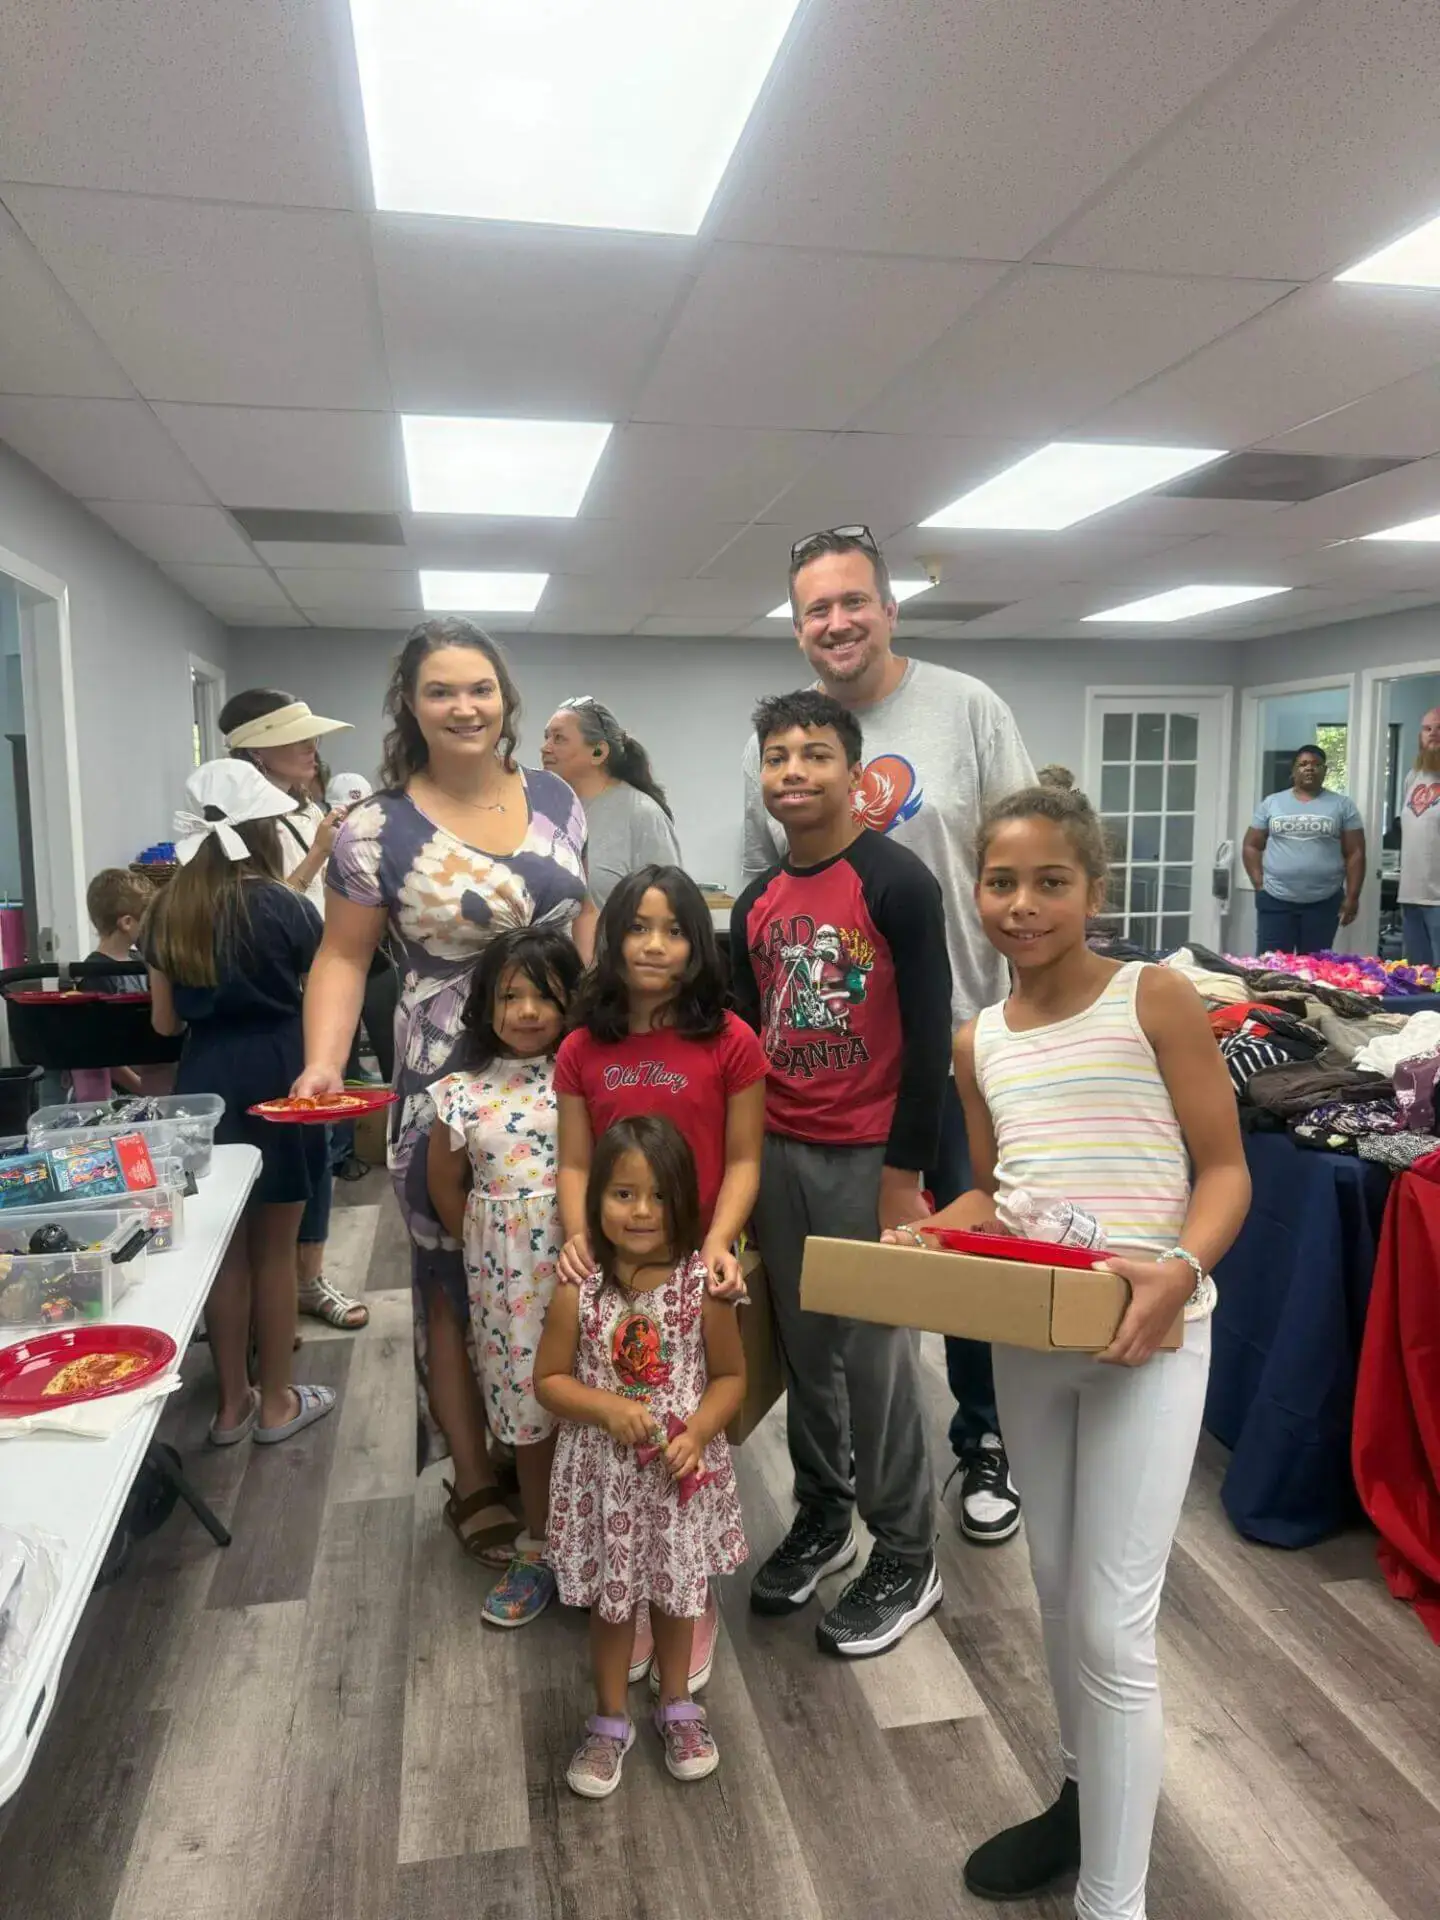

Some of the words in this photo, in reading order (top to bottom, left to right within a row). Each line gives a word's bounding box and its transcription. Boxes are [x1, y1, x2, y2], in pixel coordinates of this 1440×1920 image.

[1271, 820, 1332, 834] BOSTON
[770, 1035, 871, 1079] SANTA
[604, 1064, 640, 1090] Old
[640, 1060, 688, 1094] Navy
